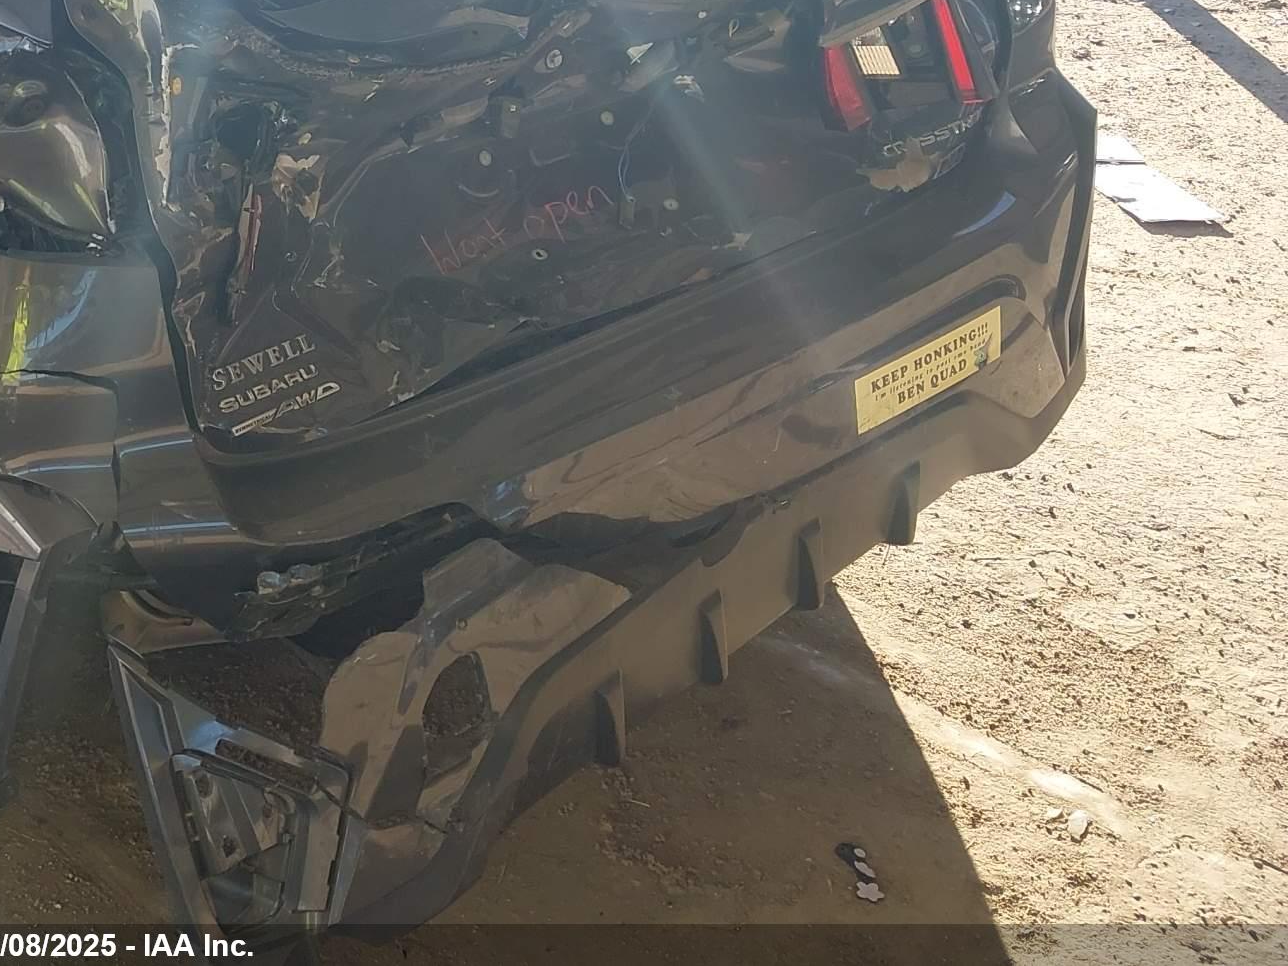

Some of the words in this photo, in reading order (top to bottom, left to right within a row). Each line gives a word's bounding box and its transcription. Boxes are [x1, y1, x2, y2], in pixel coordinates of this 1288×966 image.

[523, 185, 614, 244] open
[212, 334, 315, 391] SEWELL
[871, 365, 908, 393] KEEP
[913, 322, 989, 371] HONKING!!!
[897, 380, 925, 404] BEN
[929, 358, 967, 389] QUAD
[219, 364, 319, 413] SUBARU
[275, 382, 341, 419] AWD
